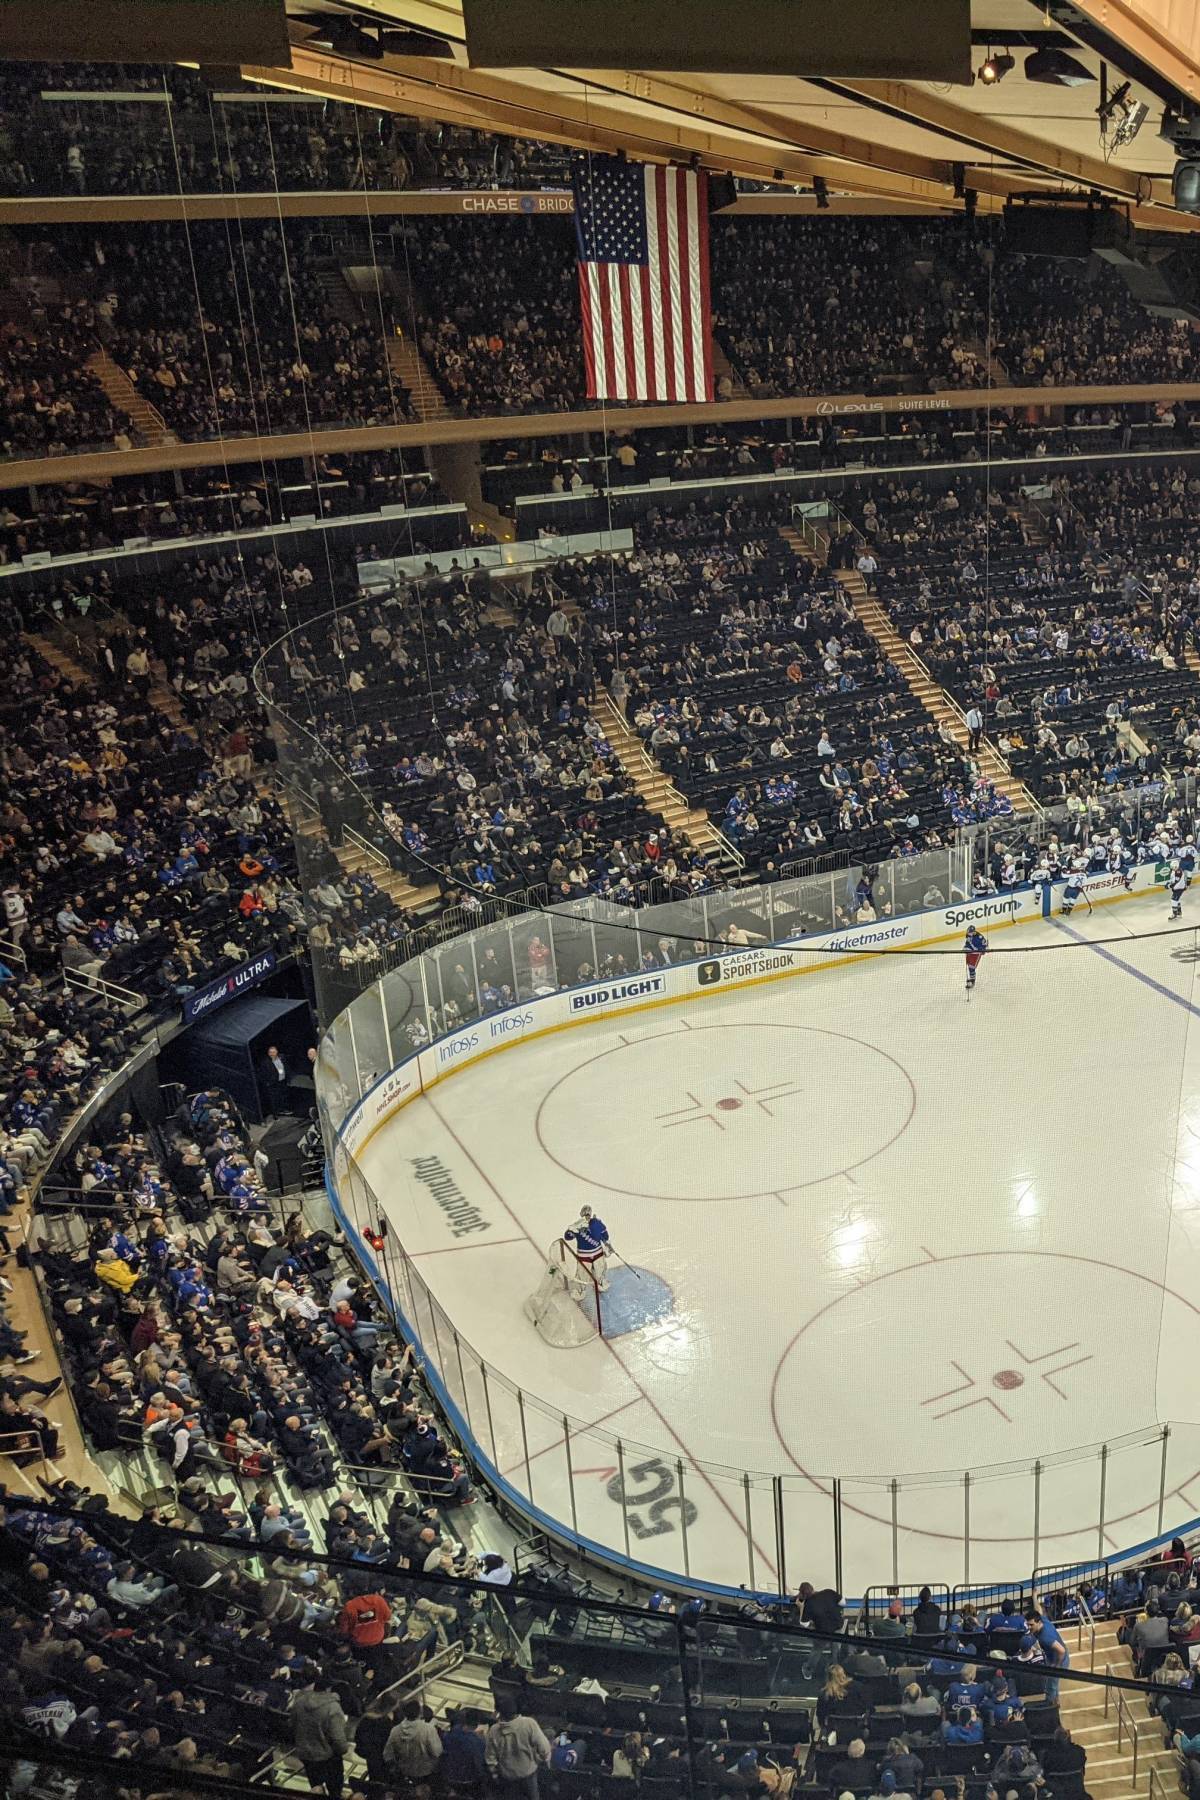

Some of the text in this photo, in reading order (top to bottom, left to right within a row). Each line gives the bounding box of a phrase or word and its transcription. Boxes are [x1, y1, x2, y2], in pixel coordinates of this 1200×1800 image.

[463, 198, 519, 211] CHASE
[835, 402, 884, 413] LEXUS
[899, 399, 950, 410] SUITE LEVEL
[945, 900, 1018, 927] Spectrum
[829, 925, 909, 950] ticketmaster
[722, 950, 767, 967] CAESARS
[723, 955, 794, 980] SPORTSBOOK
[236, 958, 270, 986] ULTRA
[573, 978, 663, 1010] BUD LIGHT
[490, 1010, 534, 1038] Infosys
[439, 1033, 479, 1062] Infosys
[607, 1457, 698, 1540] 5G
